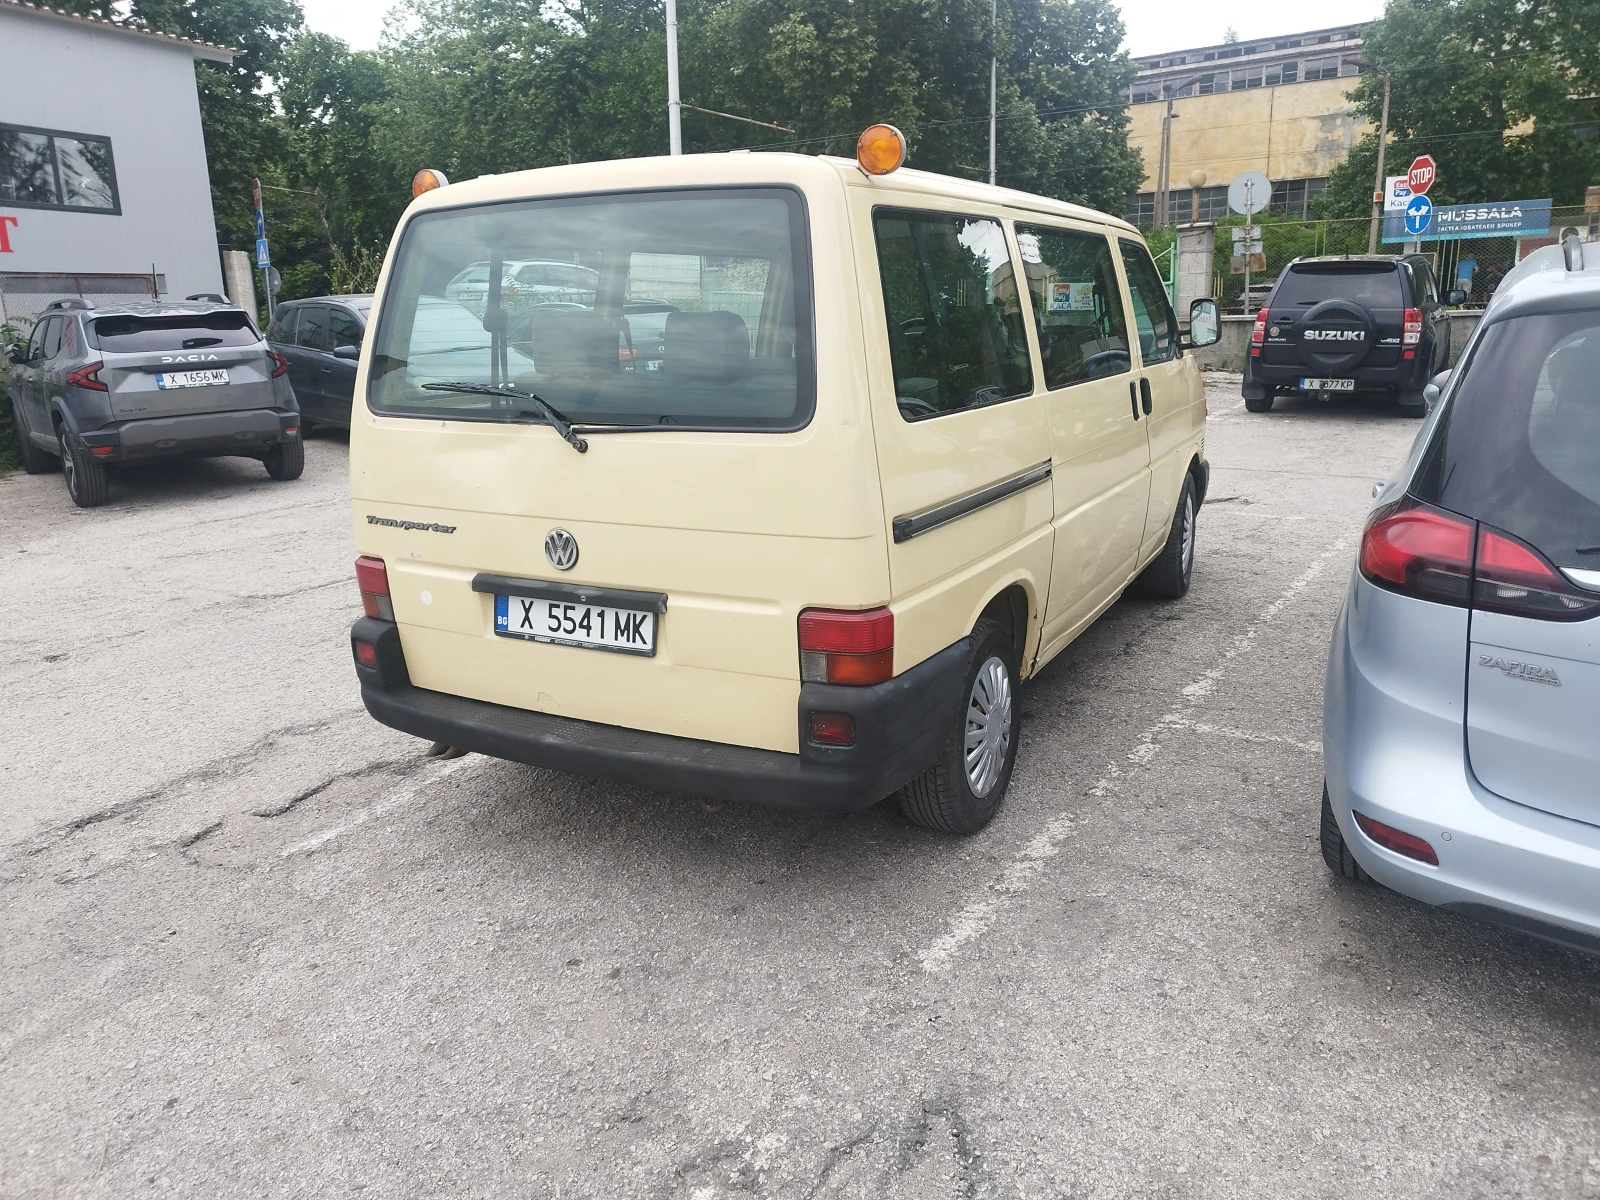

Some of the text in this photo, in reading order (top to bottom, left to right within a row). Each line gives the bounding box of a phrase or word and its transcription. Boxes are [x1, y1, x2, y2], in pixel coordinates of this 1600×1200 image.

[1411, 167, 1432, 185] STOP
[1438, 206, 1522, 222] MUSSALA
[1304, 330, 1366, 341] SUZUKI
[161, 354, 219, 363] DACIA
[169, 370, 227, 384] X 1656 MK
[1308, 380, 1315, 388] X
[1340, 380, 1353, 388] KP
[366, 515, 457, 534] Transporter
[497, 615, 508, 625] BG
[520, 599, 648, 645] X 5541 MK
[1479, 655, 1559, 681] ZAFIRA
